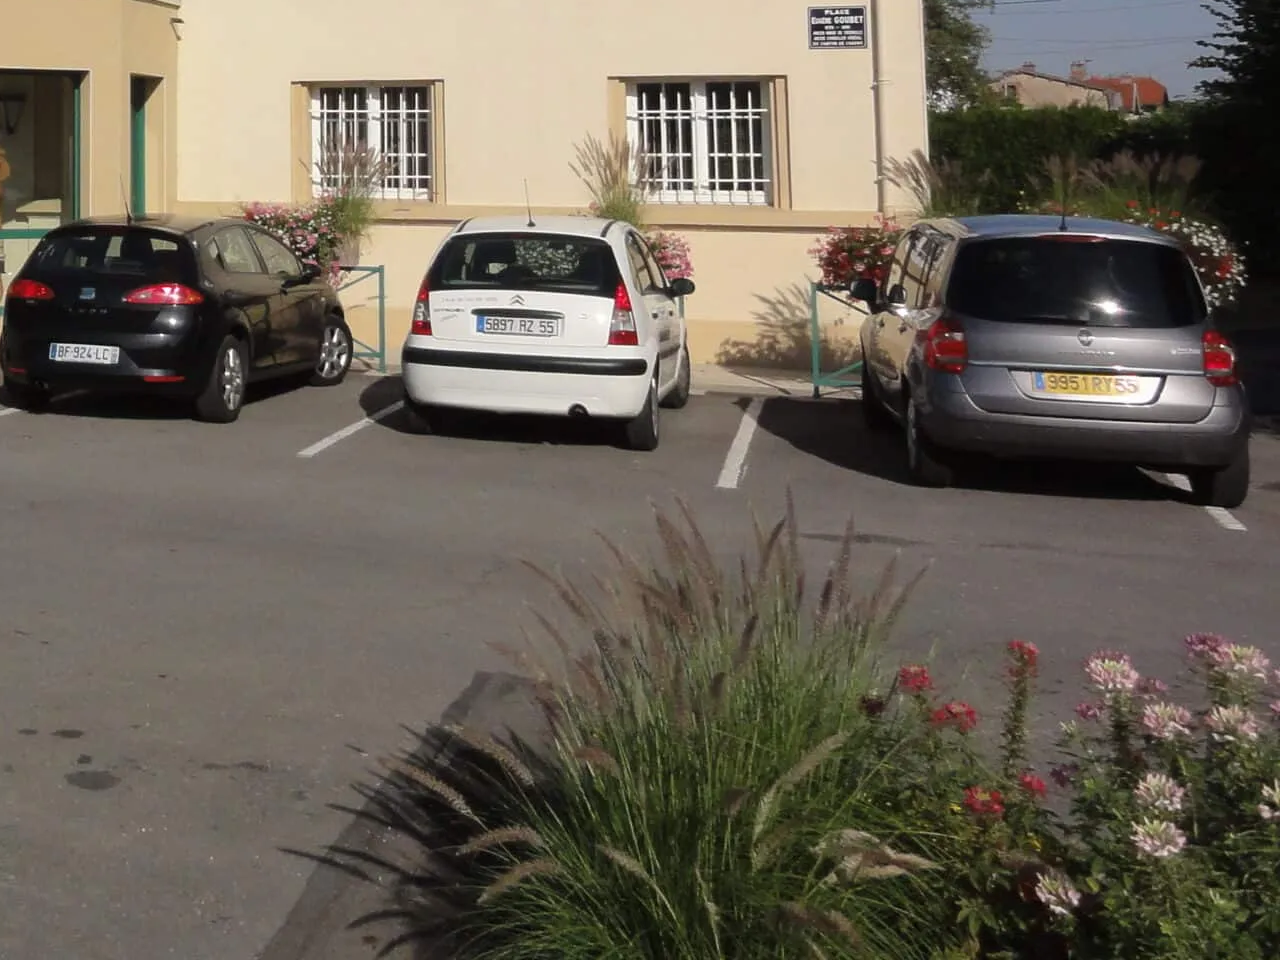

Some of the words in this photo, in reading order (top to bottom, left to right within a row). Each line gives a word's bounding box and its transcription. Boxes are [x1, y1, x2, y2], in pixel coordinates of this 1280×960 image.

[485, 318, 514, 331] 5897
[539, 320, 554, 334] 55
[1046, 374, 1089, 391] 9951
[1114, 377, 1138, 394] 55
